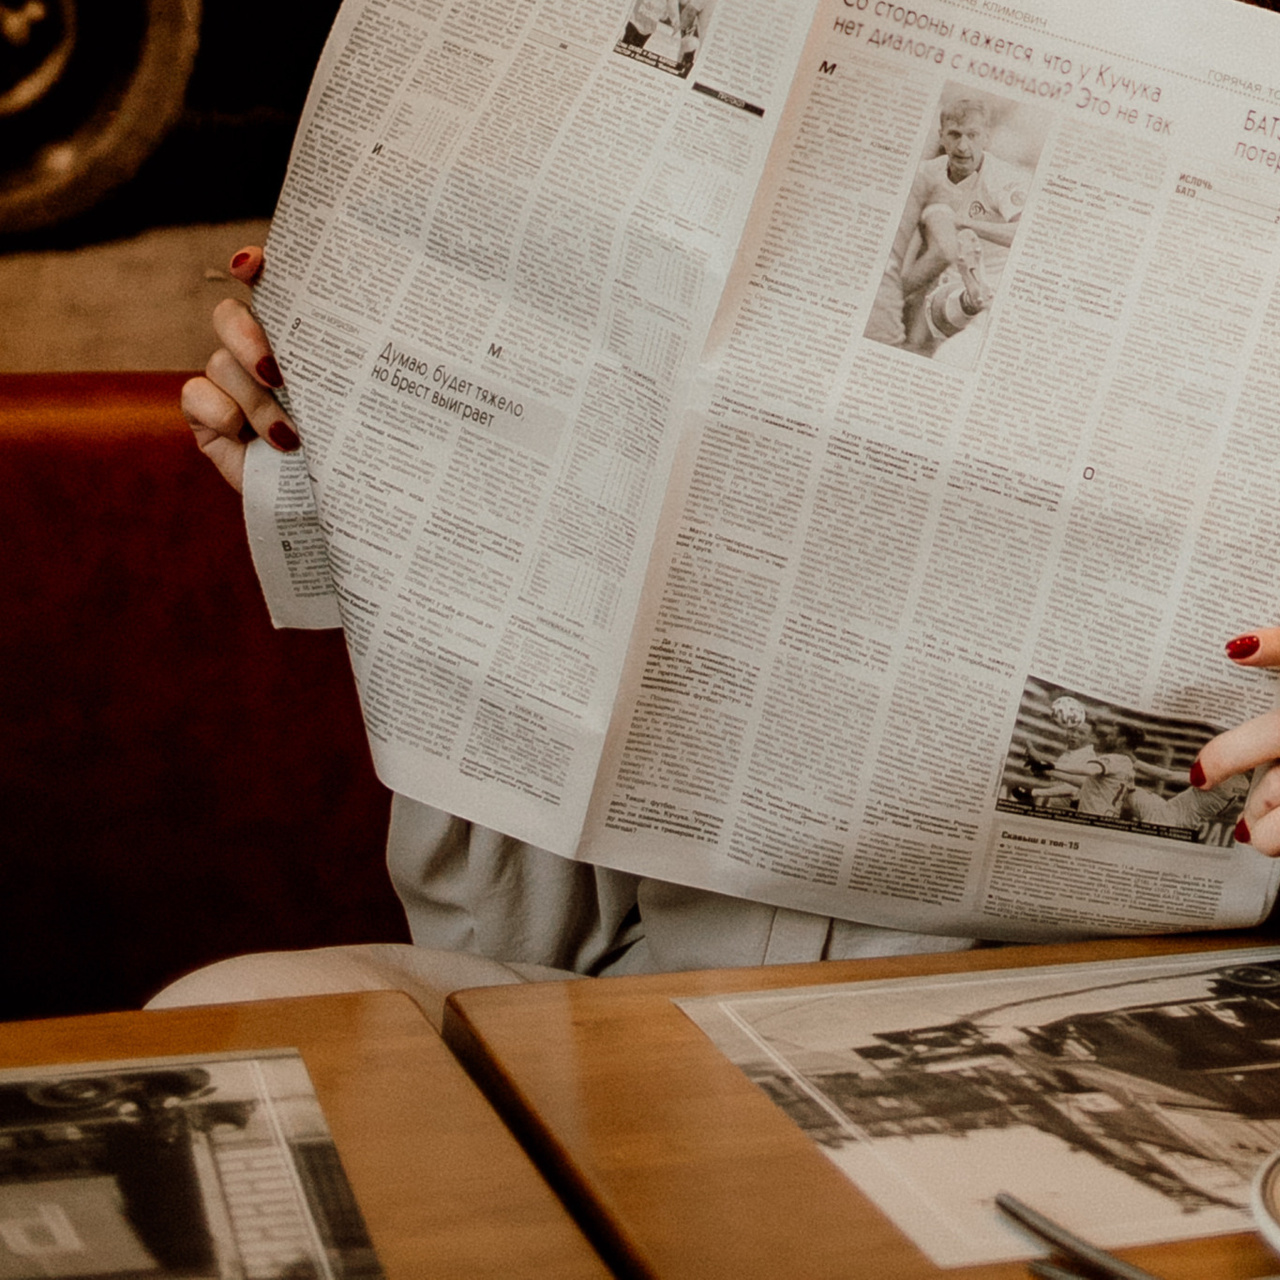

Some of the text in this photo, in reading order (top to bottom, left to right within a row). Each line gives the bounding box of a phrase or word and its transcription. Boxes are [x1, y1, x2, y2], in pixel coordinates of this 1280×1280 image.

[981, 0, 1048, 28] КЛИМОВИЧ
[831, 14, 866, 40] нет
[866, 26, 947, 66] диалога
[949, 52, 963, 71] с
[965, 55, 1073, 105] командой?
[1074, 86, 1114, 117] Это
[1115, 102, 1141, 125] не
[1144, 112, 1176, 136] так
[1041, 52, 1074, 76] что
[1076, 63, 1092, 86] у
[1093, 63, 1165, 106] Кучука
[1206, 68, 1263, 95] ГОРЯЧАЯ
[1177, 172, 1214, 191] ИСЛОЧЬ
[1174, 184, 1280, 224] БАТЭ 2
[369, 362, 497, 428] но Брест выиграет
[375, 340, 530, 422] Думаю, будет тяжело,
[1000, 829, 1040, 845] Скавыш
[1048, 837, 1079, 851] топ-15
